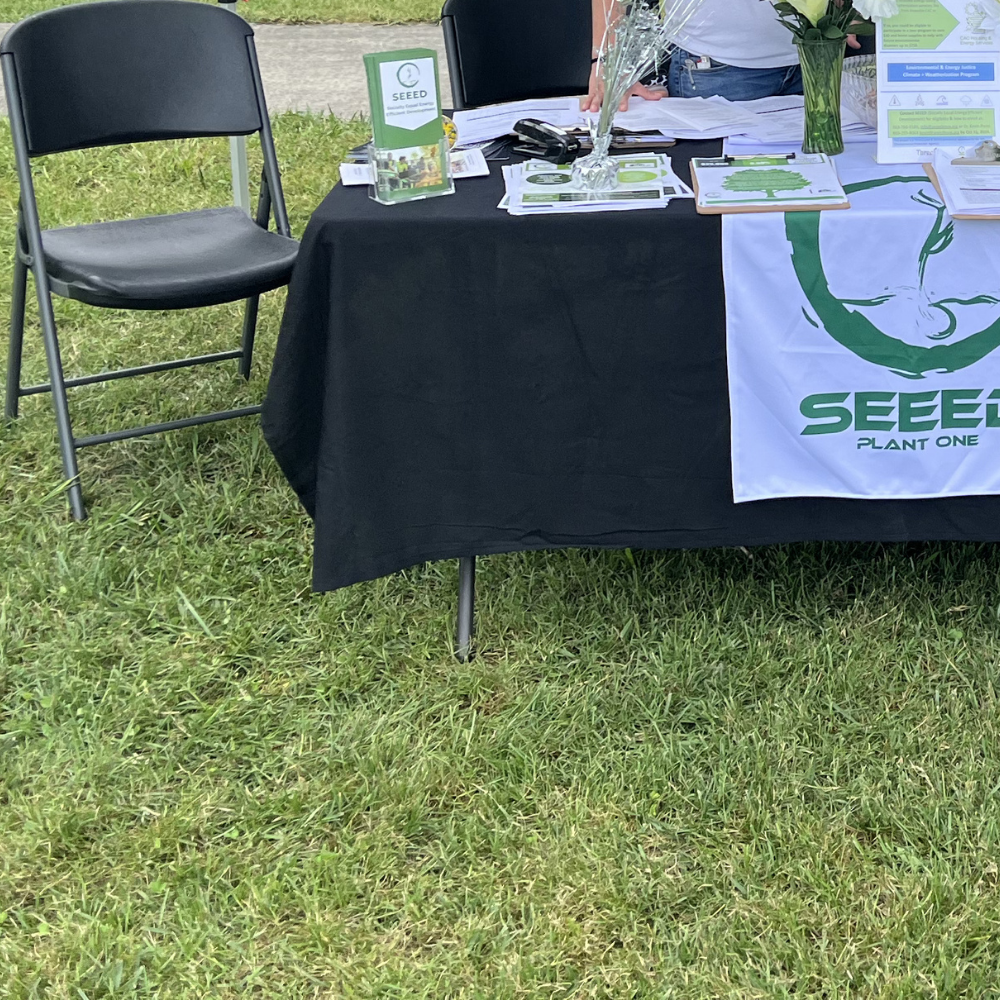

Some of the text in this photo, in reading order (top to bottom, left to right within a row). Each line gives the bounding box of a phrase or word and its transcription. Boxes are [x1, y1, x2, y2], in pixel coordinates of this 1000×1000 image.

[392, 90, 428, 102] SEEED
[857, 434, 980, 451] PLANT ONE
